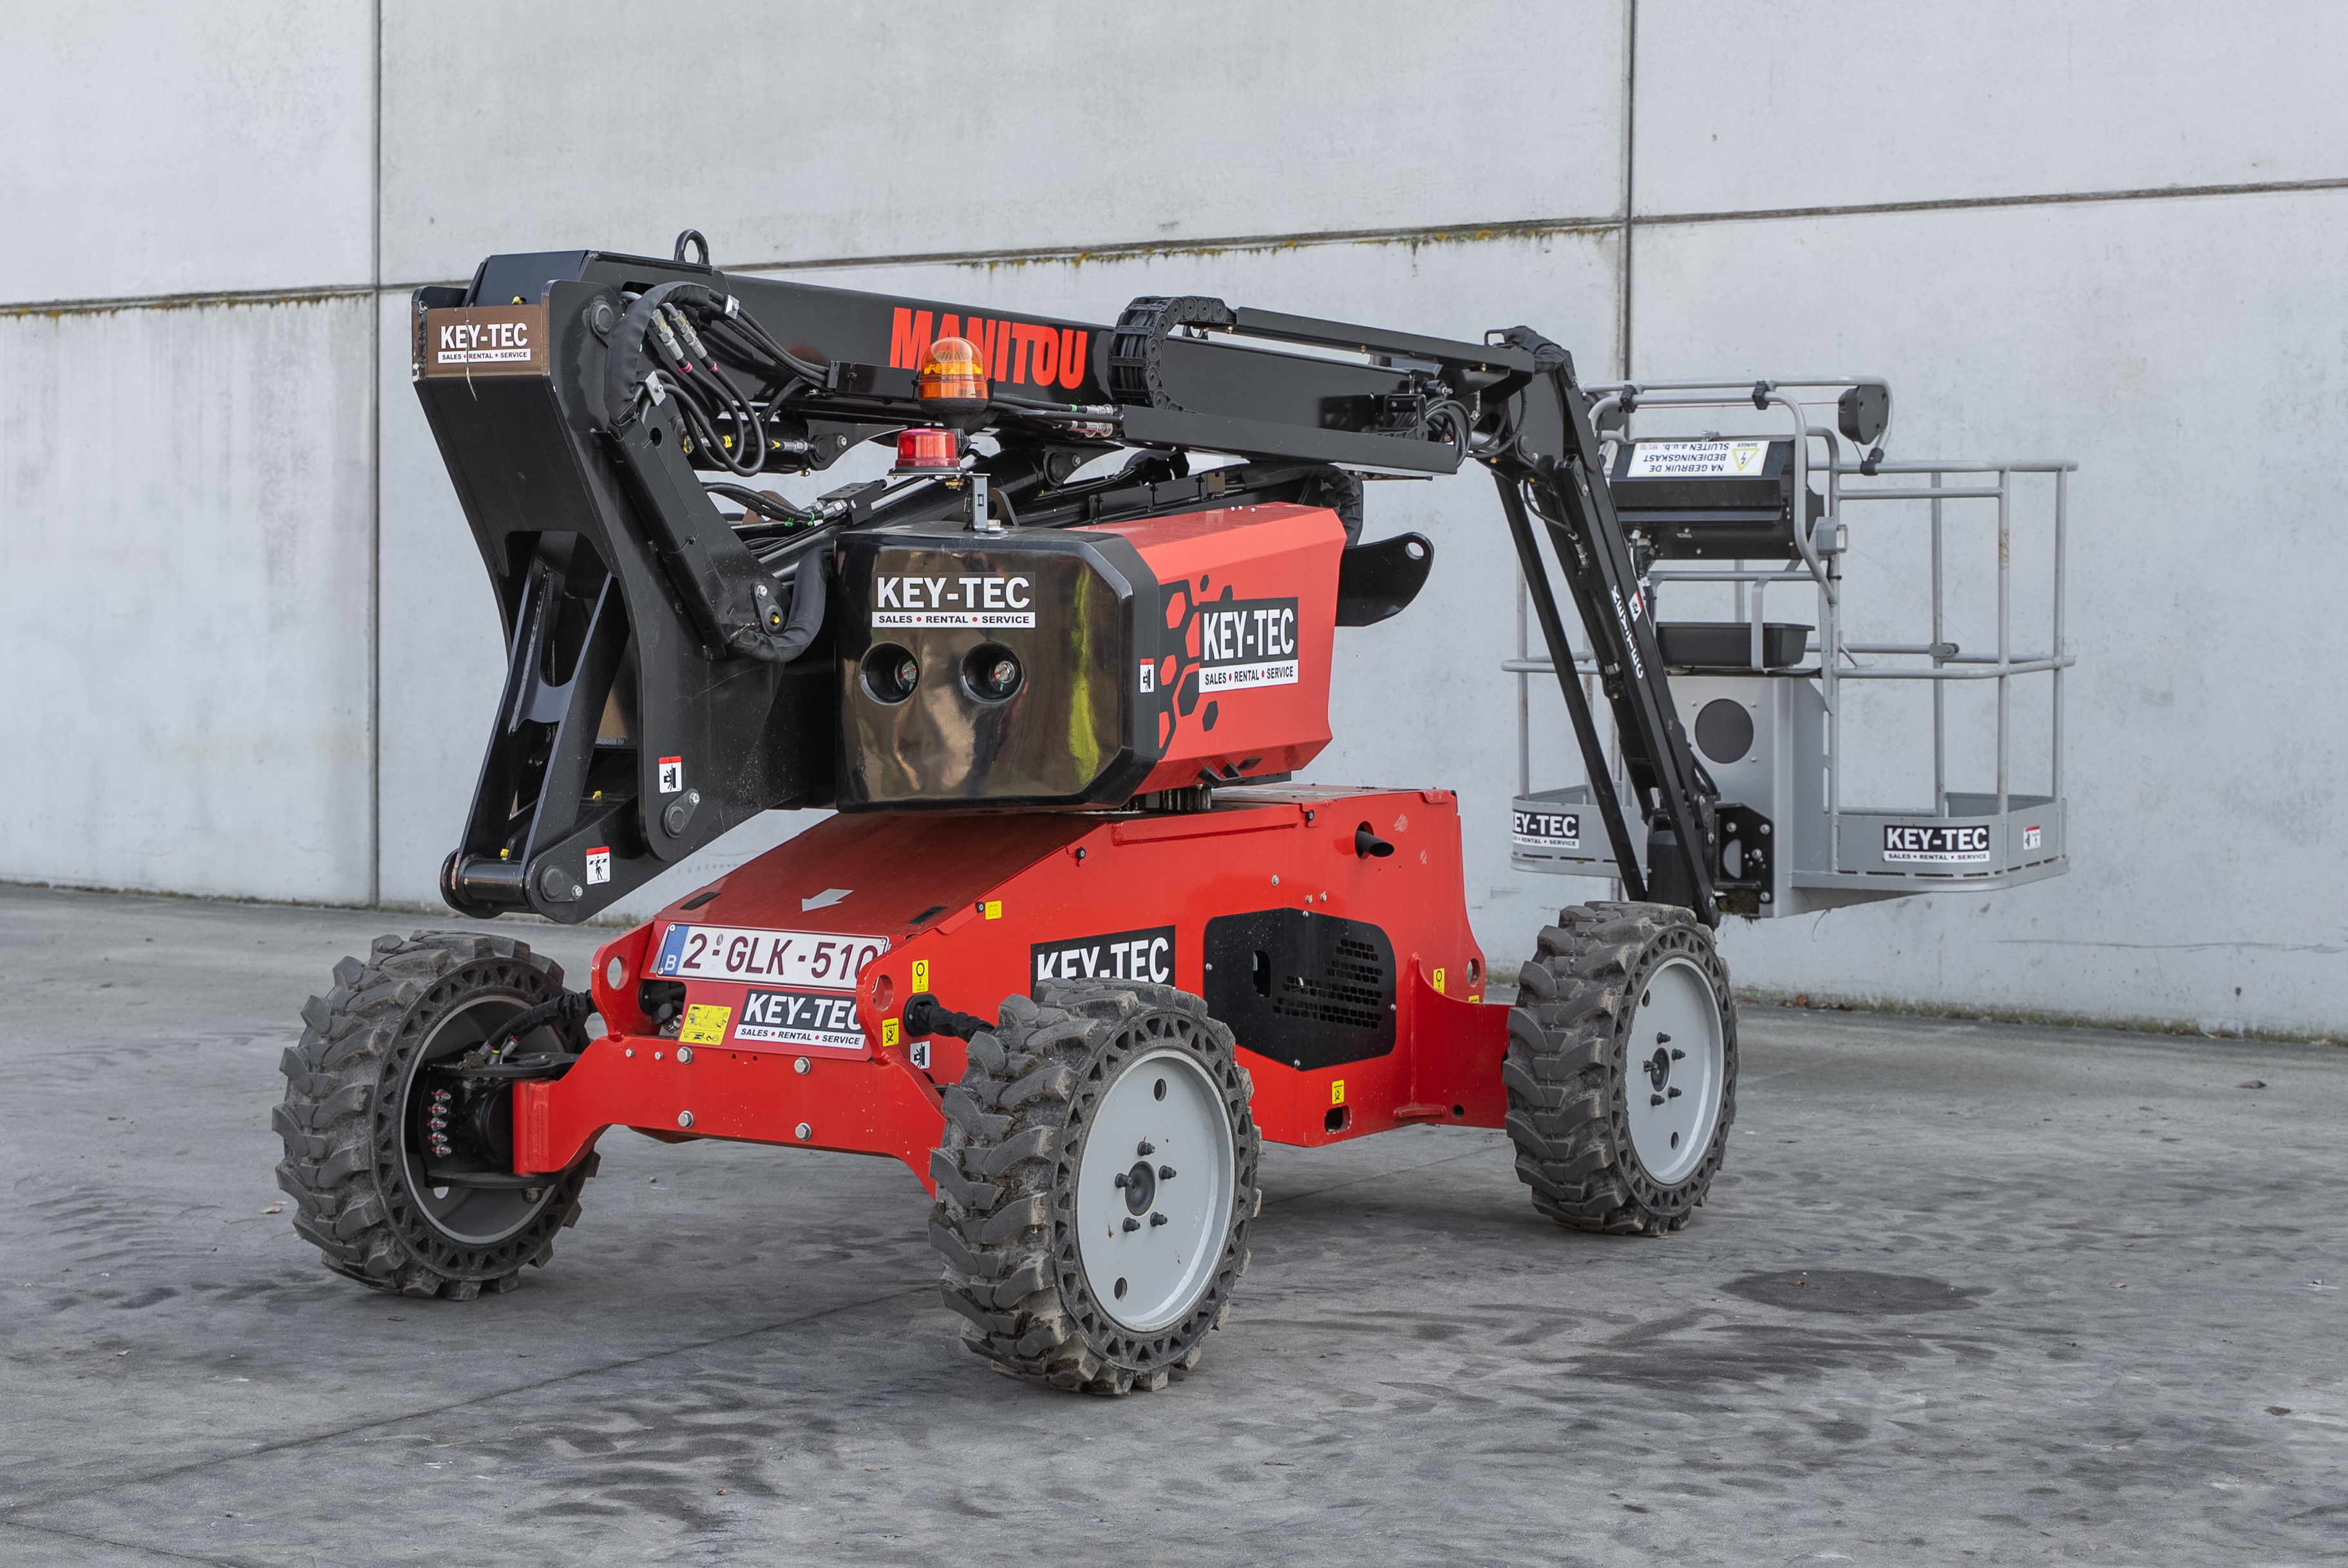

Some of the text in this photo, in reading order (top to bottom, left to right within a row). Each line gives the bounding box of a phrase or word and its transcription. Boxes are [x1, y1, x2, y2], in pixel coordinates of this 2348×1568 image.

[440, 323, 528, 349] KEY-TEC
[1643, 453, 1727, 462] BEDIENINGSKAST
[877, 577, 1030, 609] KEY-TEC
[981, 616, 1030, 624] SERVICE
[1204, 608, 1294, 661] KEY-TEC
[1611, 585, 1643, 679] KEY-TEC
[1205, 666, 1294, 685] SALES RENTAL SERVICE
[1513, 812, 1577, 836] EY-TEC
[1886, 827, 1987, 850] KEY-TEC
[664, 954, 677, 971] B
[741, 1028, 860, 1045] SALES RENTAL SERVICE
